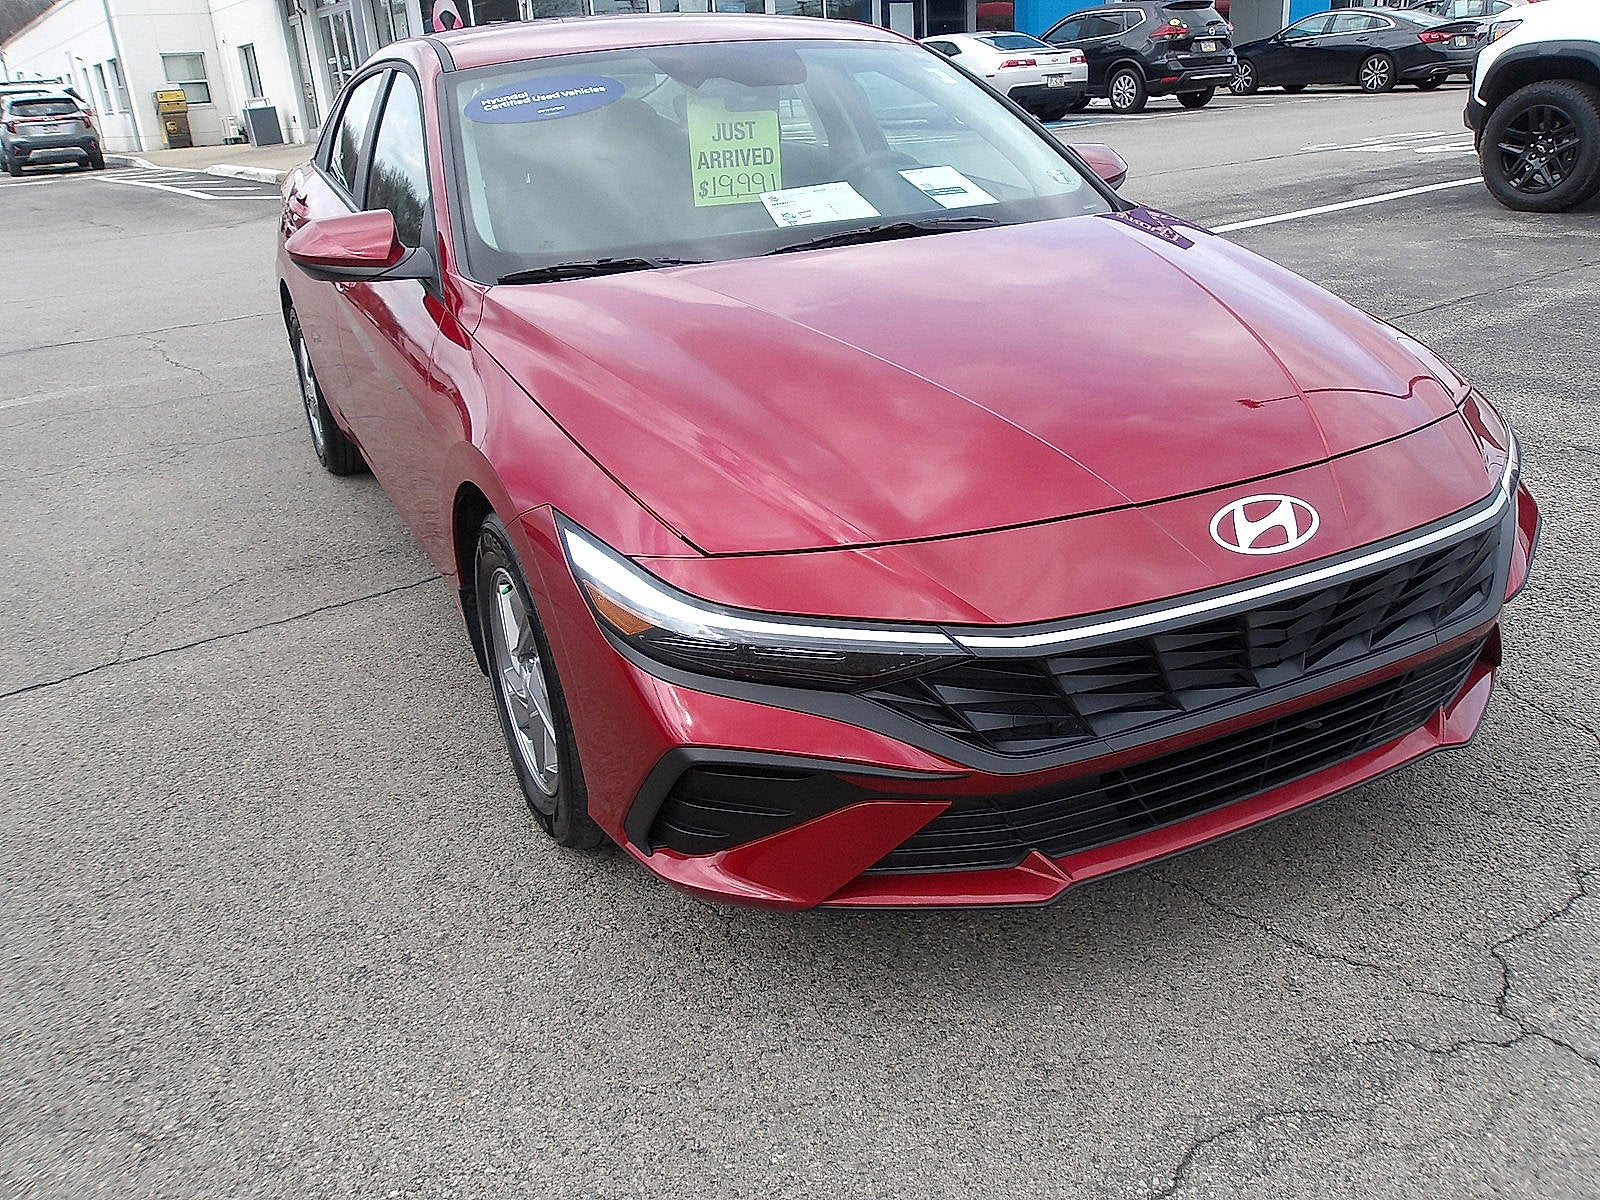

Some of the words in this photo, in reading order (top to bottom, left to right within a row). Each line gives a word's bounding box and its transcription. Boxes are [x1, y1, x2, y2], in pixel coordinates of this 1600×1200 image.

[481, 91, 529, 106] Hyundai
[483, 97, 531, 112] Certified
[532, 91, 560, 102] Used
[560, 86, 606, 97] Vehicles
[712, 121, 756, 142] JUST
[697, 147, 774, 170] ARRIVED
